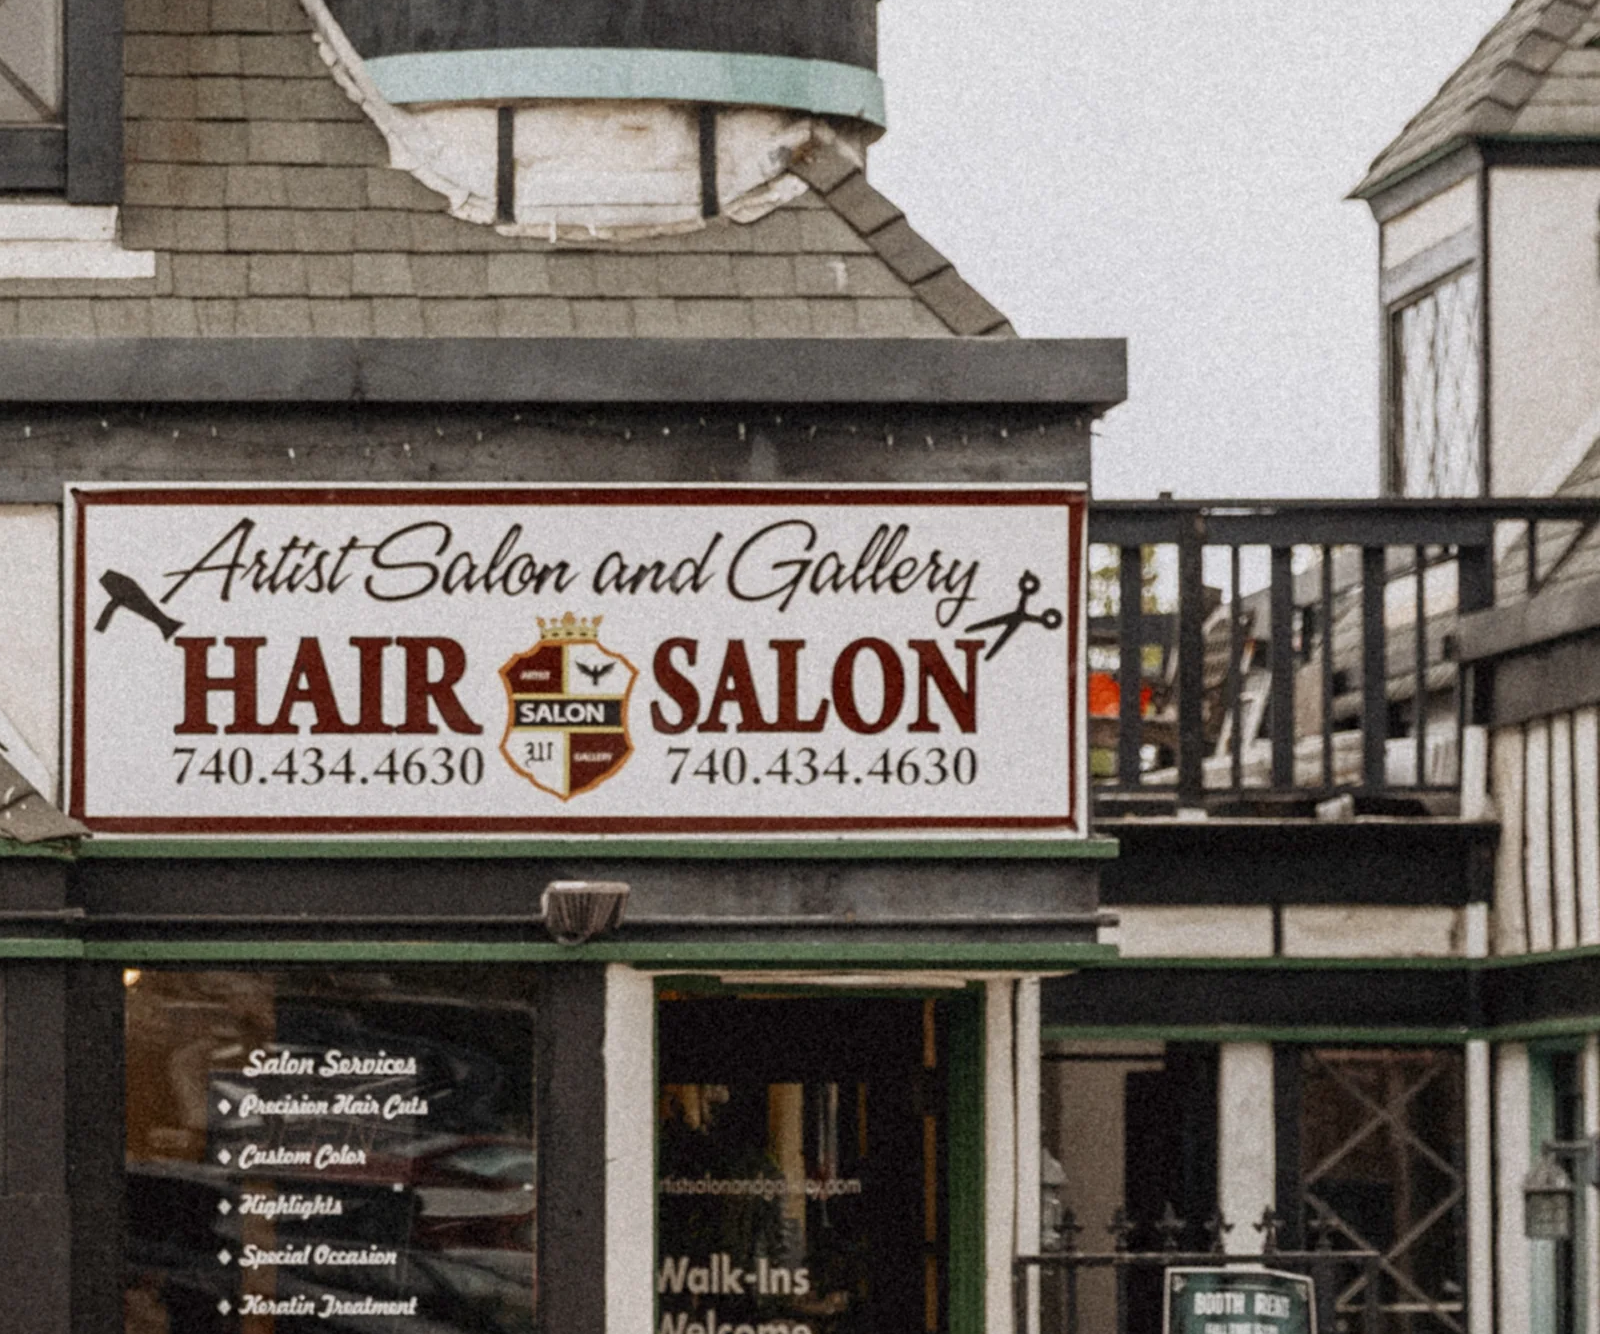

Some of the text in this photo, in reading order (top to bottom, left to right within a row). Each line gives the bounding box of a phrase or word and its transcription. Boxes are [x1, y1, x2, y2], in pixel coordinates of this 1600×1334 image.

[161, 517, 980, 629] Artist Salon and Gallery
[173, 635, 986, 735] HAIR SALON
[519, 703, 605, 723] SALON
[173, 747, 484, 788] 740.434.4630
[666, 747, 978, 788] 740.434.4630
[243, 1049, 417, 1077] Salon Services
[238, 1094, 428, 1120] Precision Hair Cuts
[238, 1144, 367, 1169] Custom Color
[238, 1195, 343, 1220] Highlights
[238, 1244, 397, 1270] Special Occasion
[657, 1253, 811, 1295] Walk-Ins
[238, 1295, 418, 1318] Keratin Treatment
